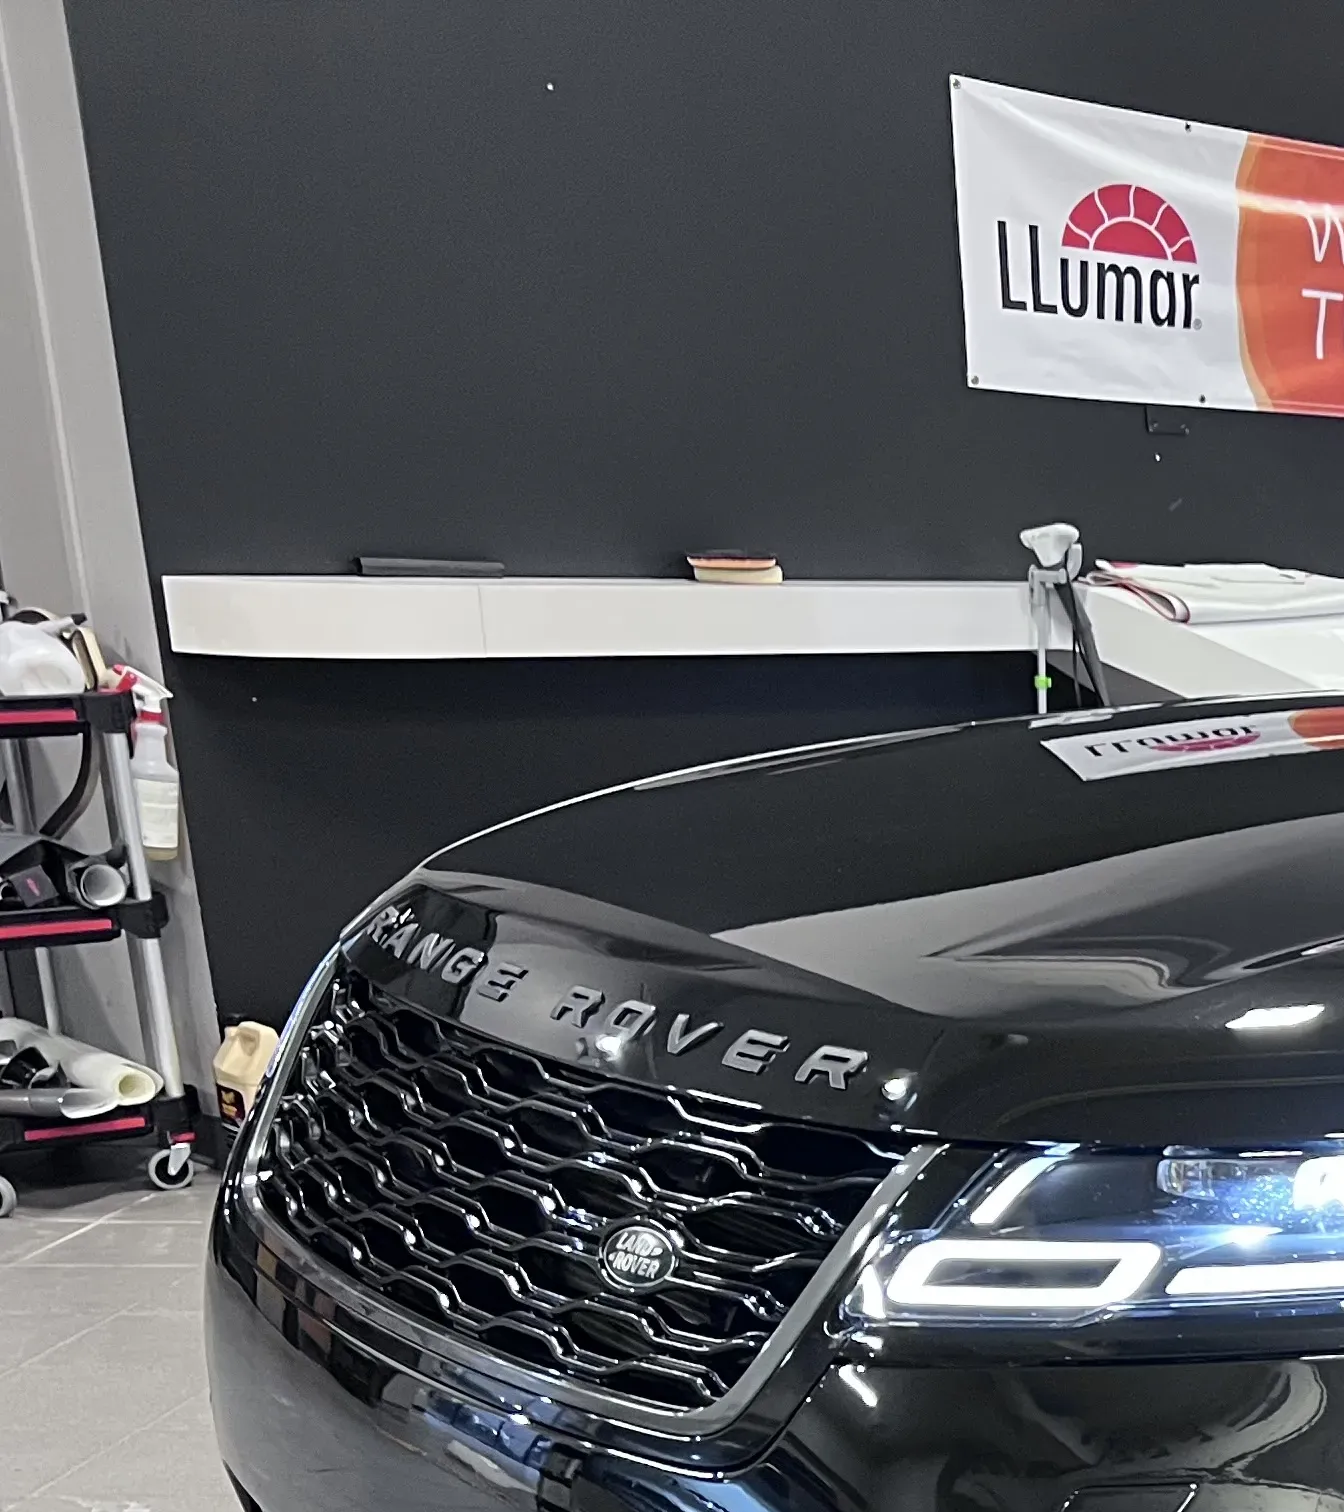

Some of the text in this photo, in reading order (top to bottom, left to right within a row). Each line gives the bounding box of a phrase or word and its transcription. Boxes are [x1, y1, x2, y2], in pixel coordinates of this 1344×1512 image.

[996, 219, 1200, 328] LLumar
[364, 904, 870, 1091] RANGE ROVER
[612, 1251, 660, 1279] ROVER
